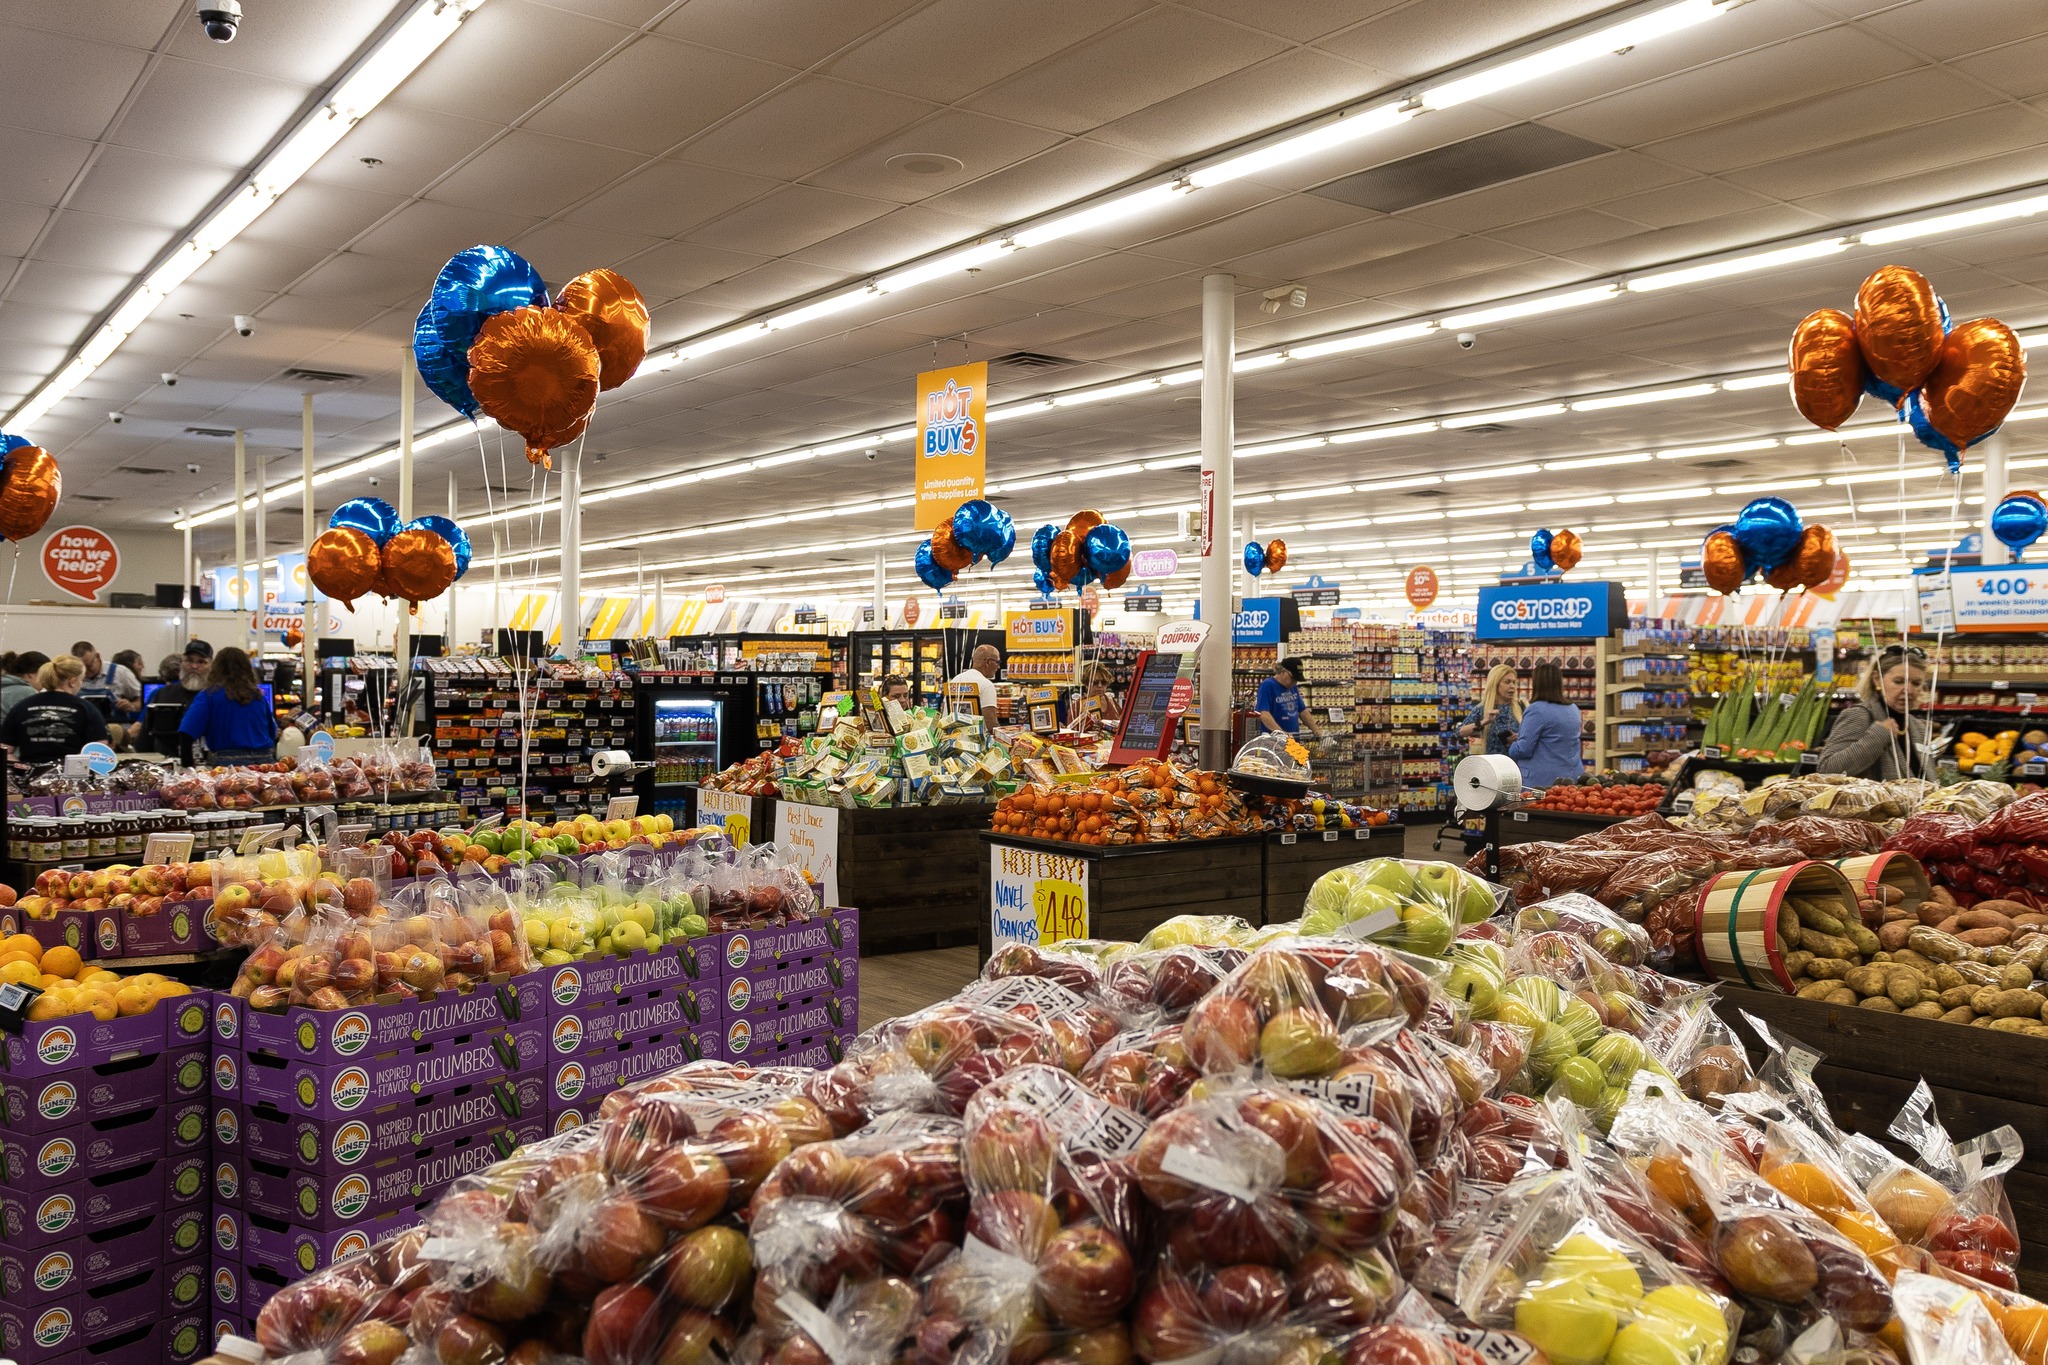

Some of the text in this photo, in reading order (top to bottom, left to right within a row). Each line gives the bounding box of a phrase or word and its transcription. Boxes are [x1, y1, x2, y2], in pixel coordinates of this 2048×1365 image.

[928, 383, 971, 424] HOT
[924, 476, 975, 490] Limited Quantity
[921, 487, 978, 501] While Supplies Last
[59, 534, 99, 548] how
[49, 548, 112, 561] can we
[57, 559, 106, 574] help?
[1137, 555, 1173, 575] infants
[1526, 563, 1536, 576] 5
[1140, 585, 1146, 595] 7
[1312, 577, 1319, 588] 6
[1541, 600, 1589, 617] DROP
[1013, 618, 1033, 634] HOT
[1500, 622, 1508, 630] Our
[1509, 622, 1519, 630] Cost
[1557, 621, 1569, 629] Save
[1570, 620, 1582, 629] More
[1161, 632, 1201, 645] COUPONS
[787, 806, 802, 825] Best
[1000, 848, 1036, 878] HOT
[728, 950, 750, 961] SUNSET
[777, 926, 827, 954] CUCUMBERS
[553, 985, 581, 998] SUNSET
[586, 967, 615, 984] INSPIRED
[617, 955, 680, 987] CUCUMBERS
[729, 993, 751, 1004] SUNSET
[779, 966, 828, 995] CUCUMBERS
[333, 995, 498, 1048] SUNSET INSPIRED CUCUMBERS
[554, 999, 681, 1046] SUNSET INSPIRED CUCUMBERS
[729, 1035, 750, 1046] SUNSET
[779, 1005, 828, 1036] CUCUMBERS
[39, 1044, 75, 1058] SUNSET
[176, 1051, 207, 1068] CUCUMBERS
[333, 1045, 495, 1102] SUNSET INSPIRED CUCUMBERS
[557, 1043, 683, 1093] SUNSET INSPIRED CUCUMBERS
[40, 1098, 77, 1113] SUNSET
[175, 1104, 206, 1121] CUCUMBERS
[334, 1093, 496, 1156] SUNSET INSPIRED CUCUMBERS
[38, 1154, 75, 1169] SUNSET
[173, 1158, 205, 1176] CUCUMBERS
[334, 1142, 496, 1210] SUNSET INSPIRED CUCUMBERS
[37, 1211, 75, 1227] SUNSET
[172, 1210, 204, 1229] CUCUMBERS
[35, 1268, 73, 1285] SUNSET
[171, 1264, 204, 1283] CUCUMBERS
[35, 1324, 71, 1341] SUNSET
[170, 1317, 202, 1336] CUCUMBERS
